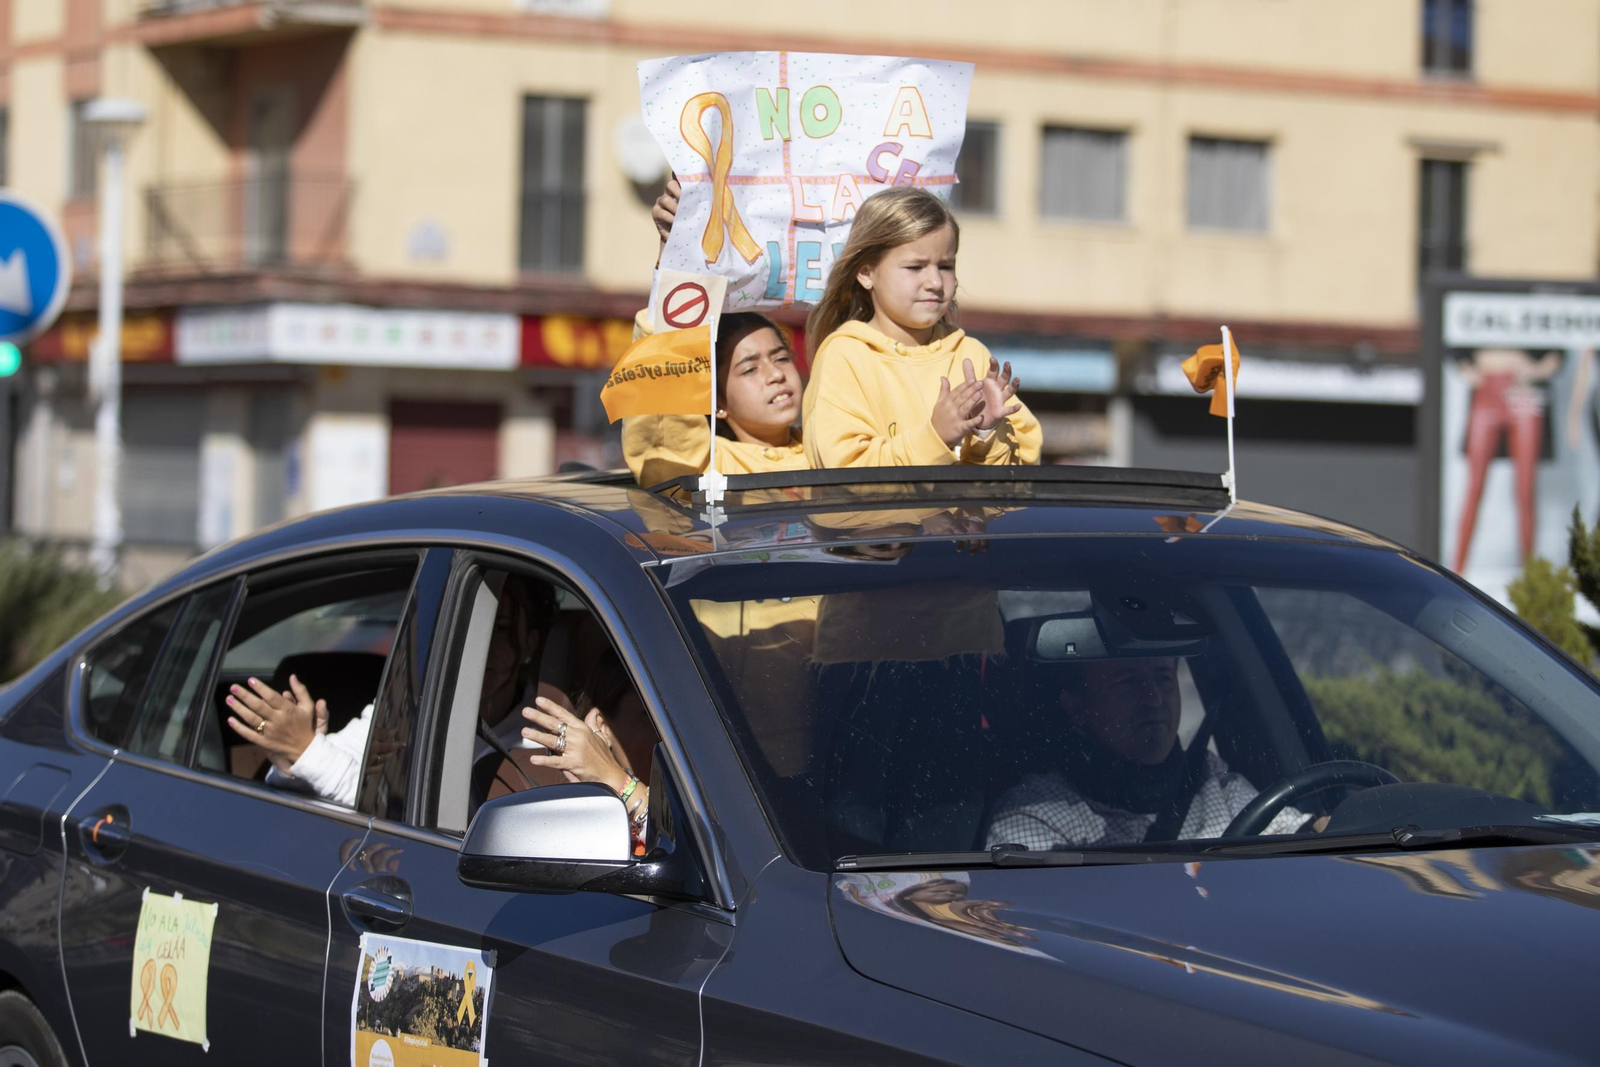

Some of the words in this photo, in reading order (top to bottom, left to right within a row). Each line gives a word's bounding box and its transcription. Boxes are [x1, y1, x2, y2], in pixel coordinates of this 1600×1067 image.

[755, 85, 842, 141] NO
[883, 86, 933, 139] A
[790, 173, 864, 222] LA
[763, 241, 845, 301] LE
[1457, 309, 1600, 331] CALZEDO
